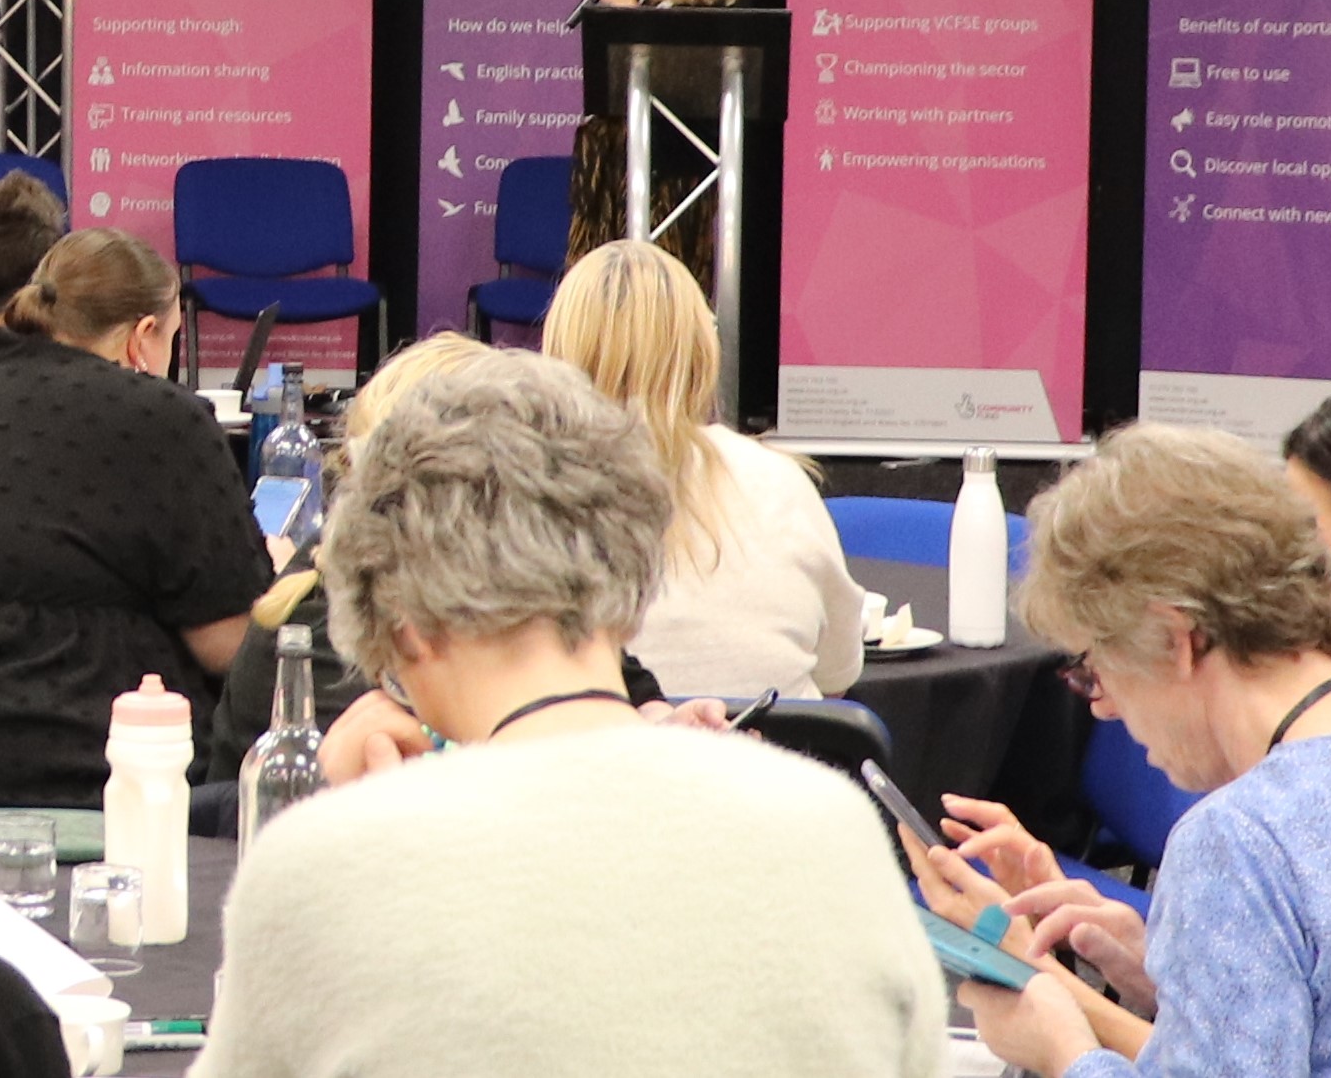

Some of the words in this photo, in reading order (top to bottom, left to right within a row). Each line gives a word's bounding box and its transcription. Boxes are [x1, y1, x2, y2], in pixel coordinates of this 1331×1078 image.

[93, 17, 176, 35] Supporting
[180, 18, 243, 35] through:
[448, 18, 482, 32] How
[486, 18, 505, 32] do
[510, 20, 532, 32] we
[536, 18, 574, 36] help
[844, 15, 930, 33] Supporting
[935, 16, 981, 30] VCFSE
[986, 19, 1038, 34] groups
[1179, 18, 1240, 34] Benefits
[1244, 18, 1259, 34] of
[1263, 21, 1289, 35] our
[121, 62, 210, 77] Information
[214, 63, 270, 81] sharing
[477, 64, 530, 82] English
[535, 65, 584, 82] practic
[844, 60, 946, 79] Championing
[951, 62, 975, 75] the
[979, 64, 1027, 76] sector
[1207, 65, 1239, 80] Free
[1244, 66, 1259, 80] to
[1263, 68, 1290, 82] use
[121, 107, 182, 124] Training
[187, 107, 214, 122] and
[218, 110, 291, 123] resources
[476, 110, 525, 127] Family
[529, 113, 581, 127] suppor
[844, 106, 906, 123] Working
[911, 107, 943, 121] with
[947, 109, 1013, 125] partners
[1206, 112, 1239, 131] Easy
[1243, 113, 1272, 128] role
[843, 152, 939, 170] Empowering
[943, 154, 1046, 172] organisations
[1205, 158, 1268, 174] Discover
[1273, 160, 1307, 175] local
[1203, 204, 1265, 221] Connect
[1269, 206, 1302, 222] with
